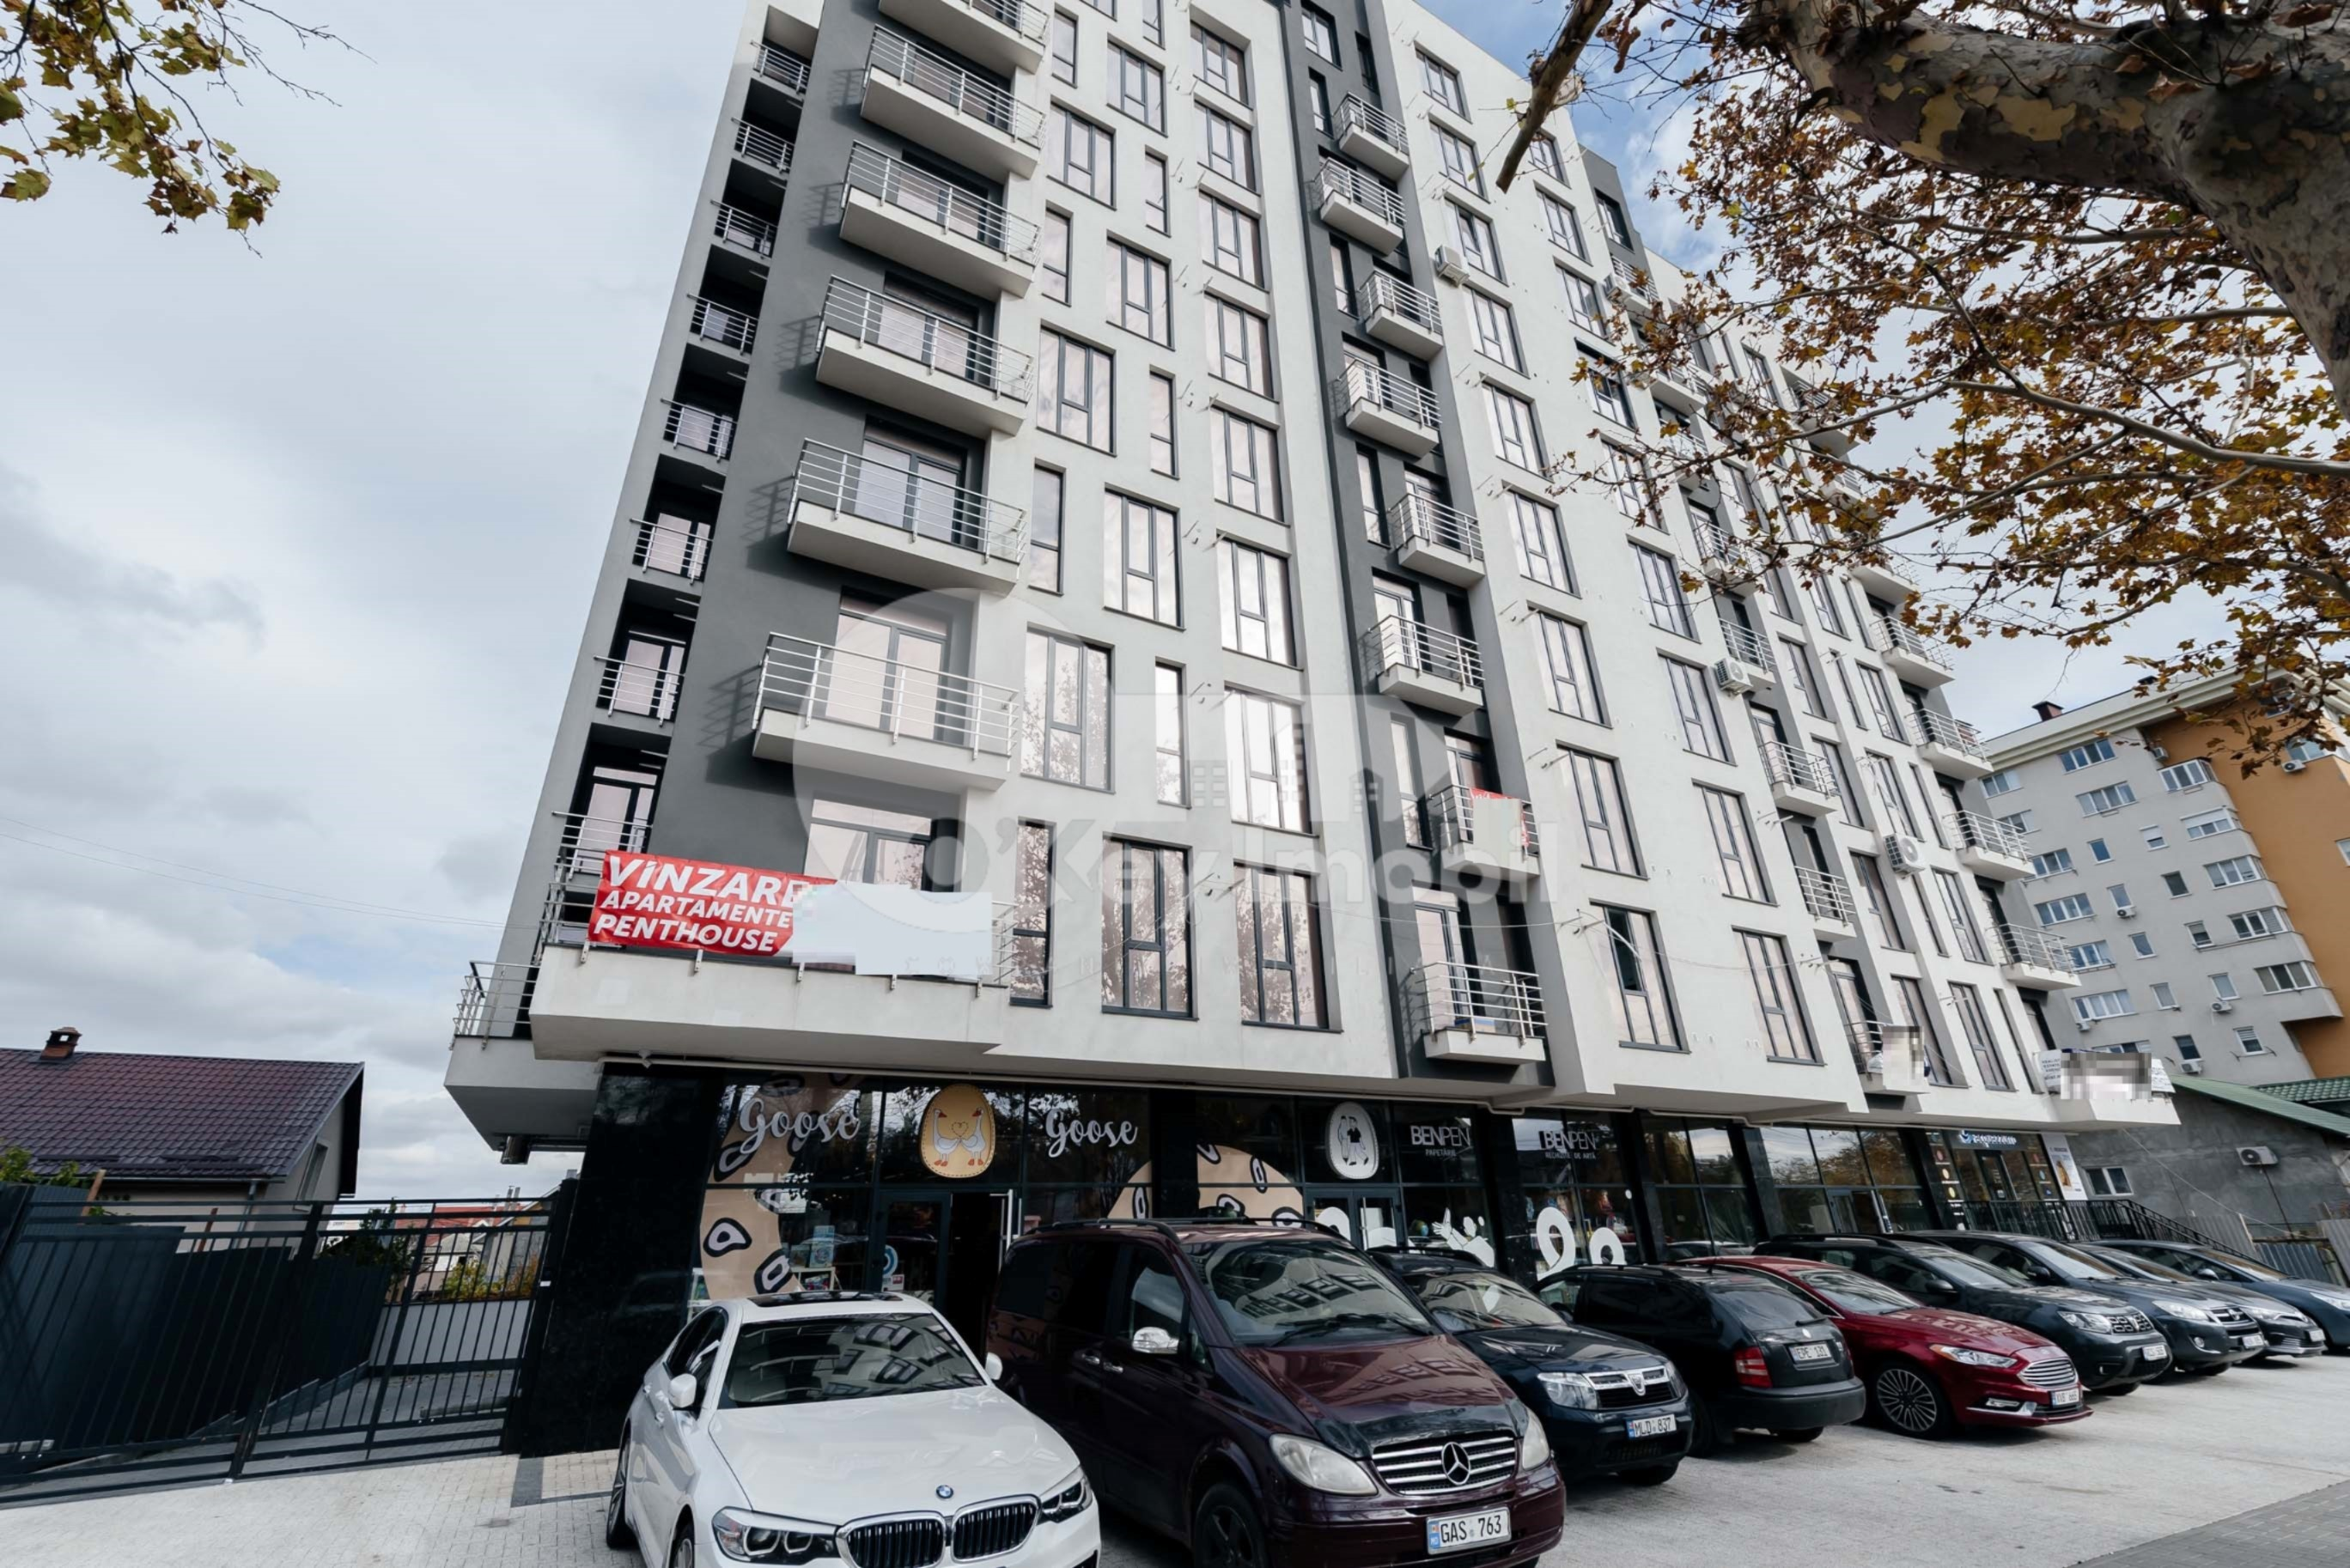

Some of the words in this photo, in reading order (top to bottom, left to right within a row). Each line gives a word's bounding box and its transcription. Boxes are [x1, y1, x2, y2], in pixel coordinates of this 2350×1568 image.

[601, 890, 793, 928] APARTAMENTE
[594, 915, 778, 951] PENTHOUSE
[740, 1097, 860, 1154] Goose
[1045, 1108, 1138, 1158] Goose
[1410, 1125, 1470, 1146] BENPEN
[1543, 1130, 1597, 1150] BENPEN
[1635, 1420, 1652, 1435] MLD
[1658, 1417, 1671, 1431] 837
[1440, 1520, 1467, 1543] GAS
[1478, 1515, 1501, 1537] 763
